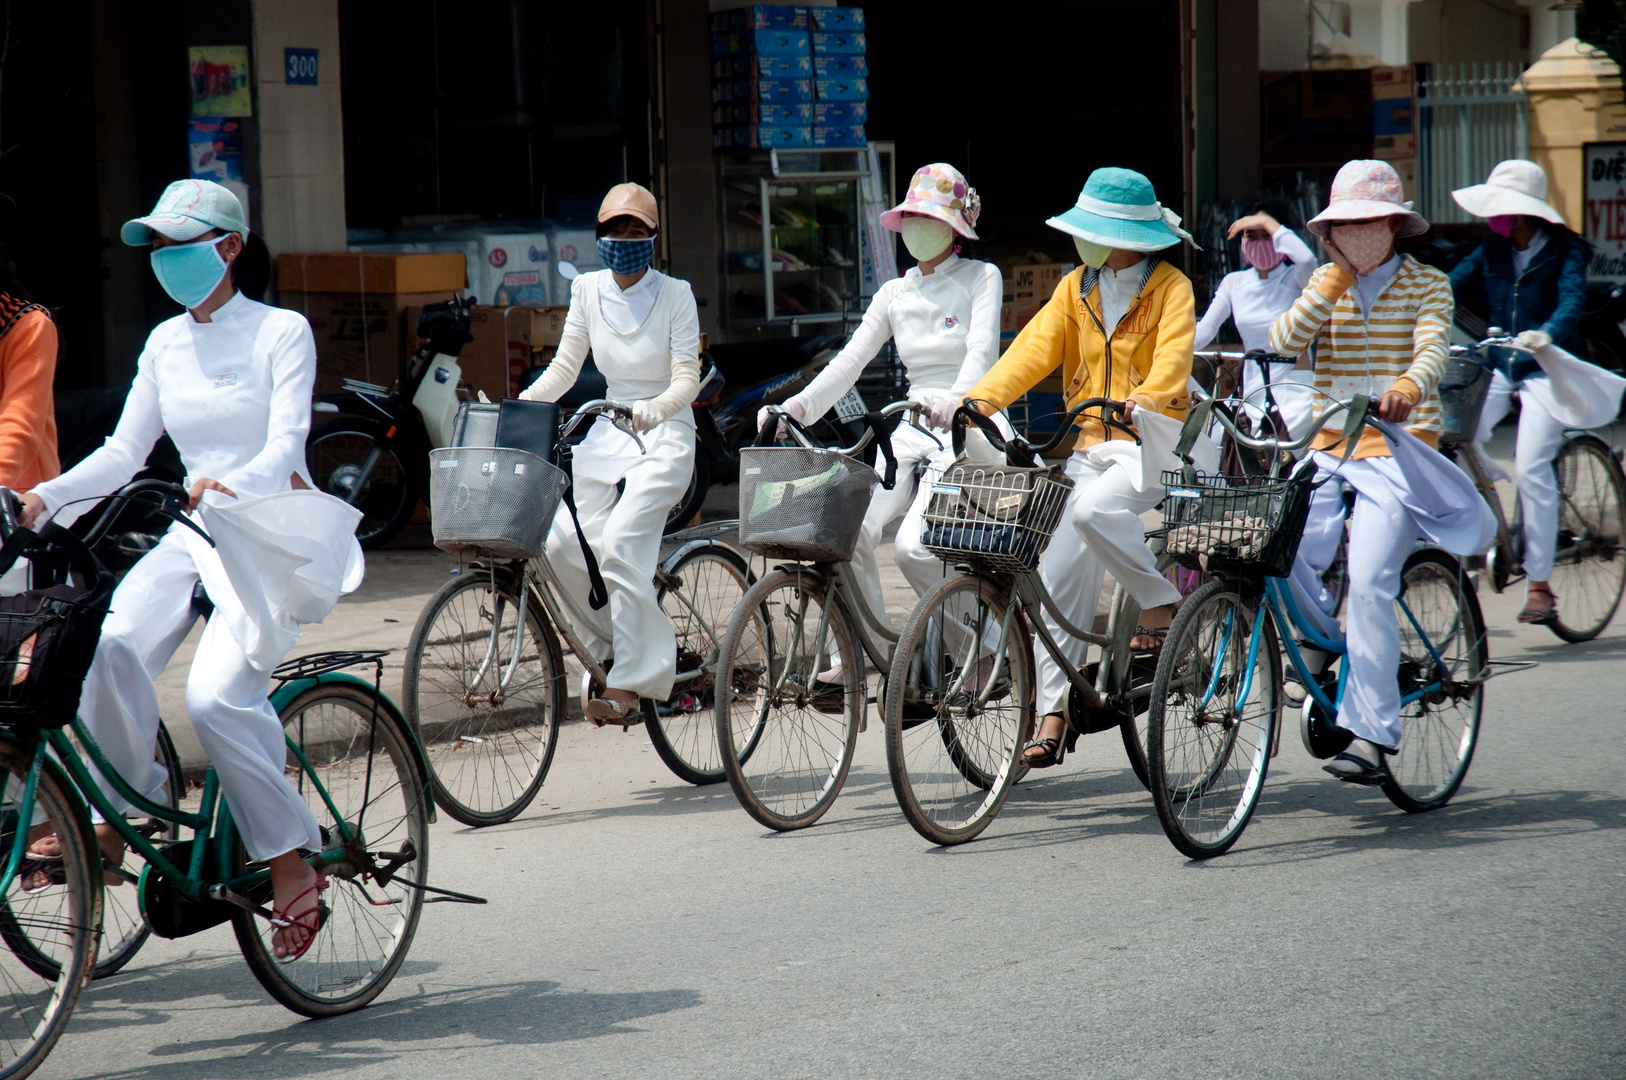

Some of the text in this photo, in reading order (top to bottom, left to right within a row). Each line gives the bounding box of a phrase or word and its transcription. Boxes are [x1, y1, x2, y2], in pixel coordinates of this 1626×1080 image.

[289, 55, 317, 78] 300
[506, 273, 537, 285] TOSHIBA
[1017, 271, 1034, 286] JVC
